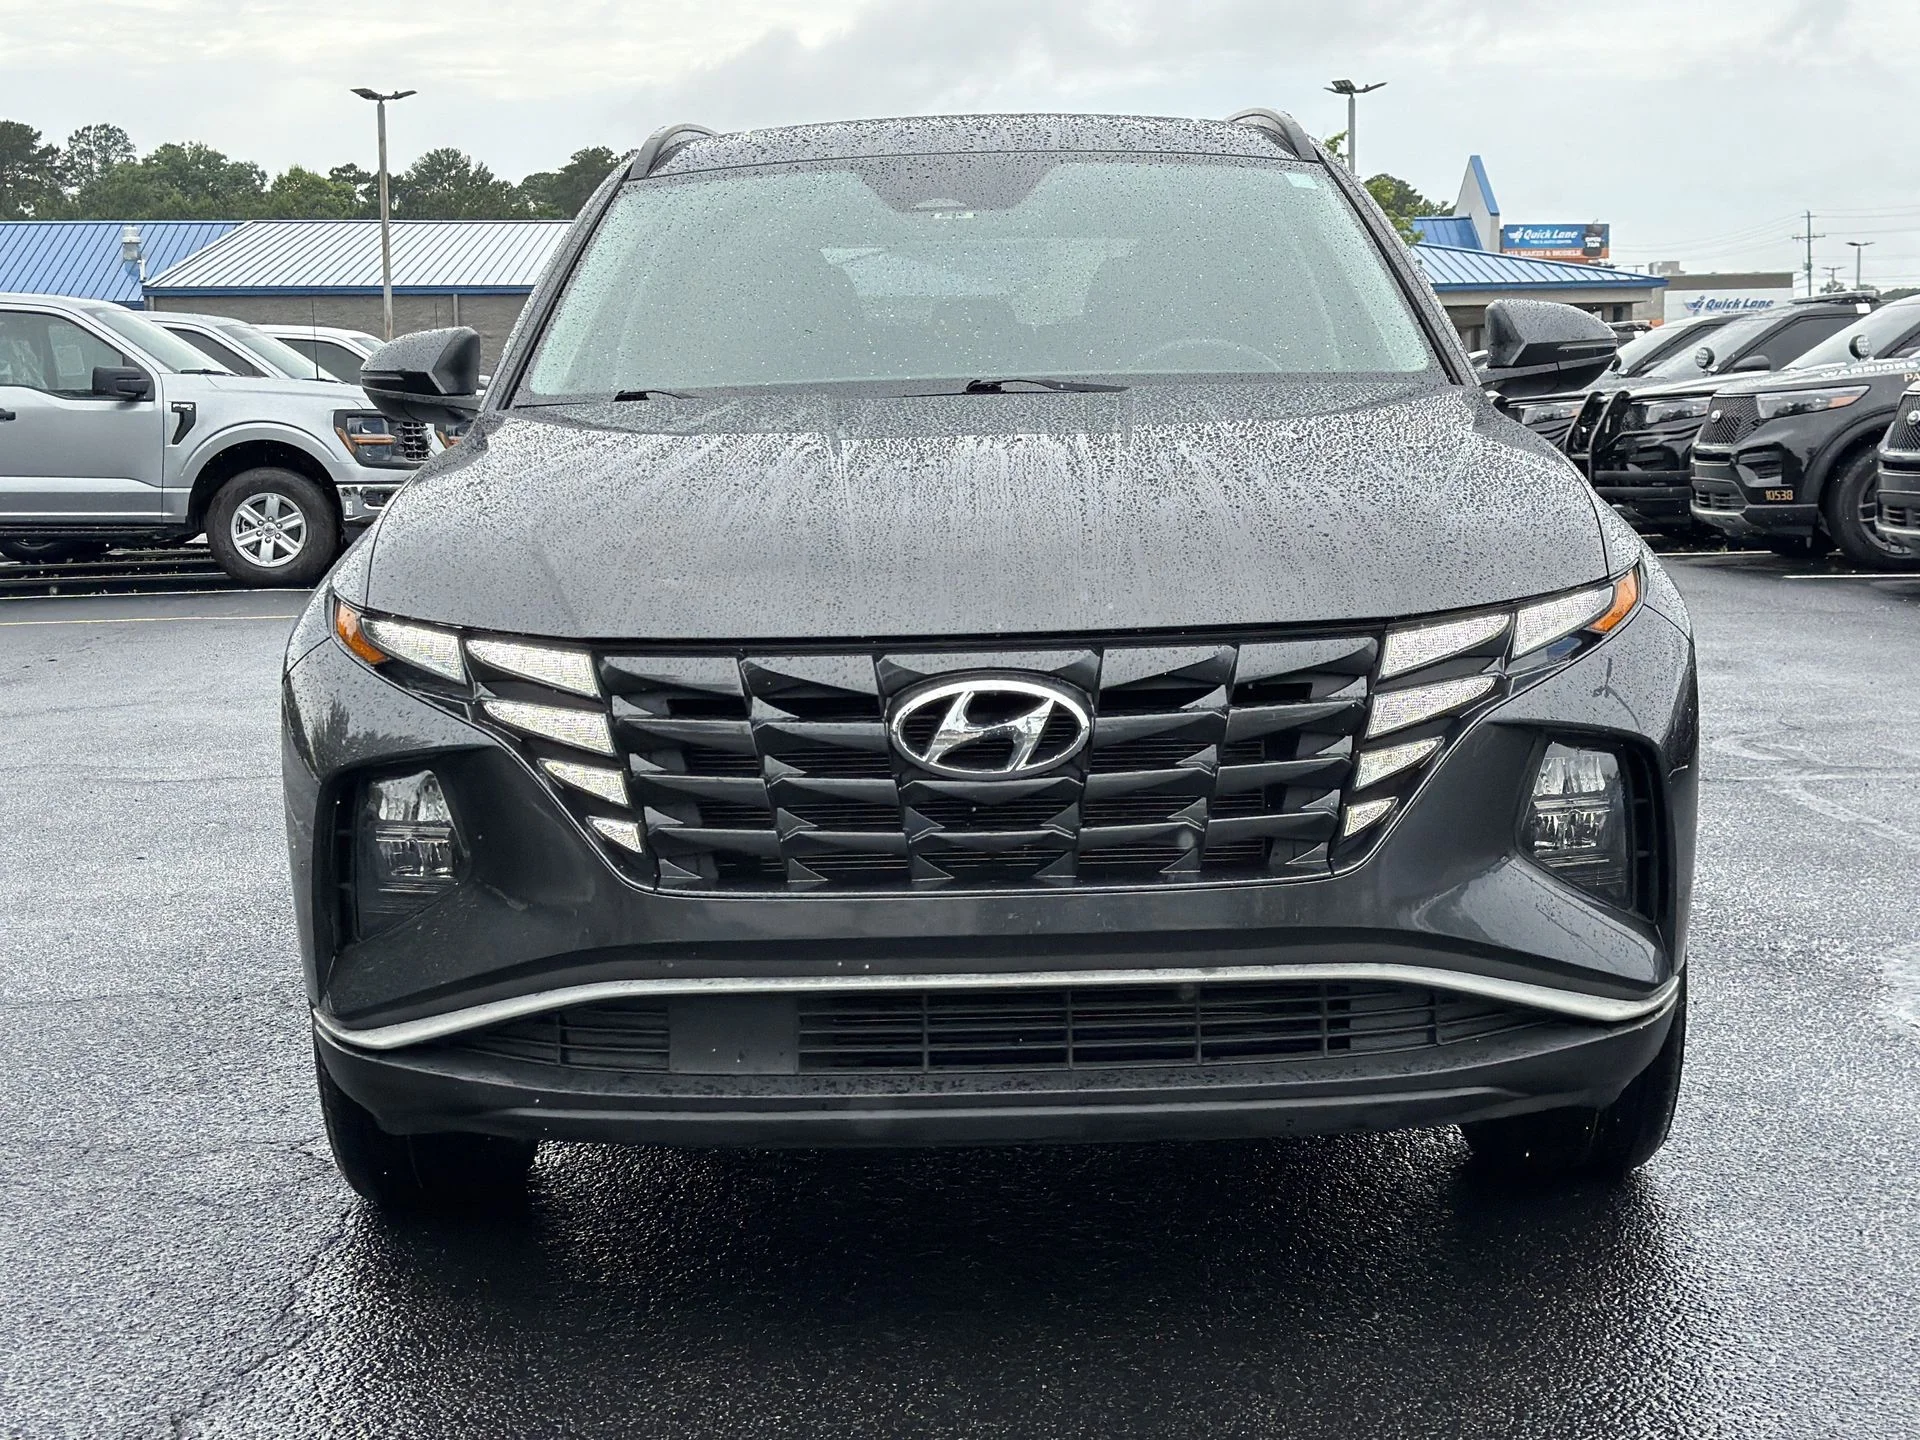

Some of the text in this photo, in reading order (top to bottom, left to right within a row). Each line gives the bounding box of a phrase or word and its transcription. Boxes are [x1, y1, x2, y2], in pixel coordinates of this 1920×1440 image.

[1523, 229, 1552, 239] Quick
[1552, 229, 1578, 239] Lane
[1706, 298, 1774, 311] Quick Lane
[1821, 361, 1919, 378] WARRIORS
[1765, 490, 1793, 500] 10538
